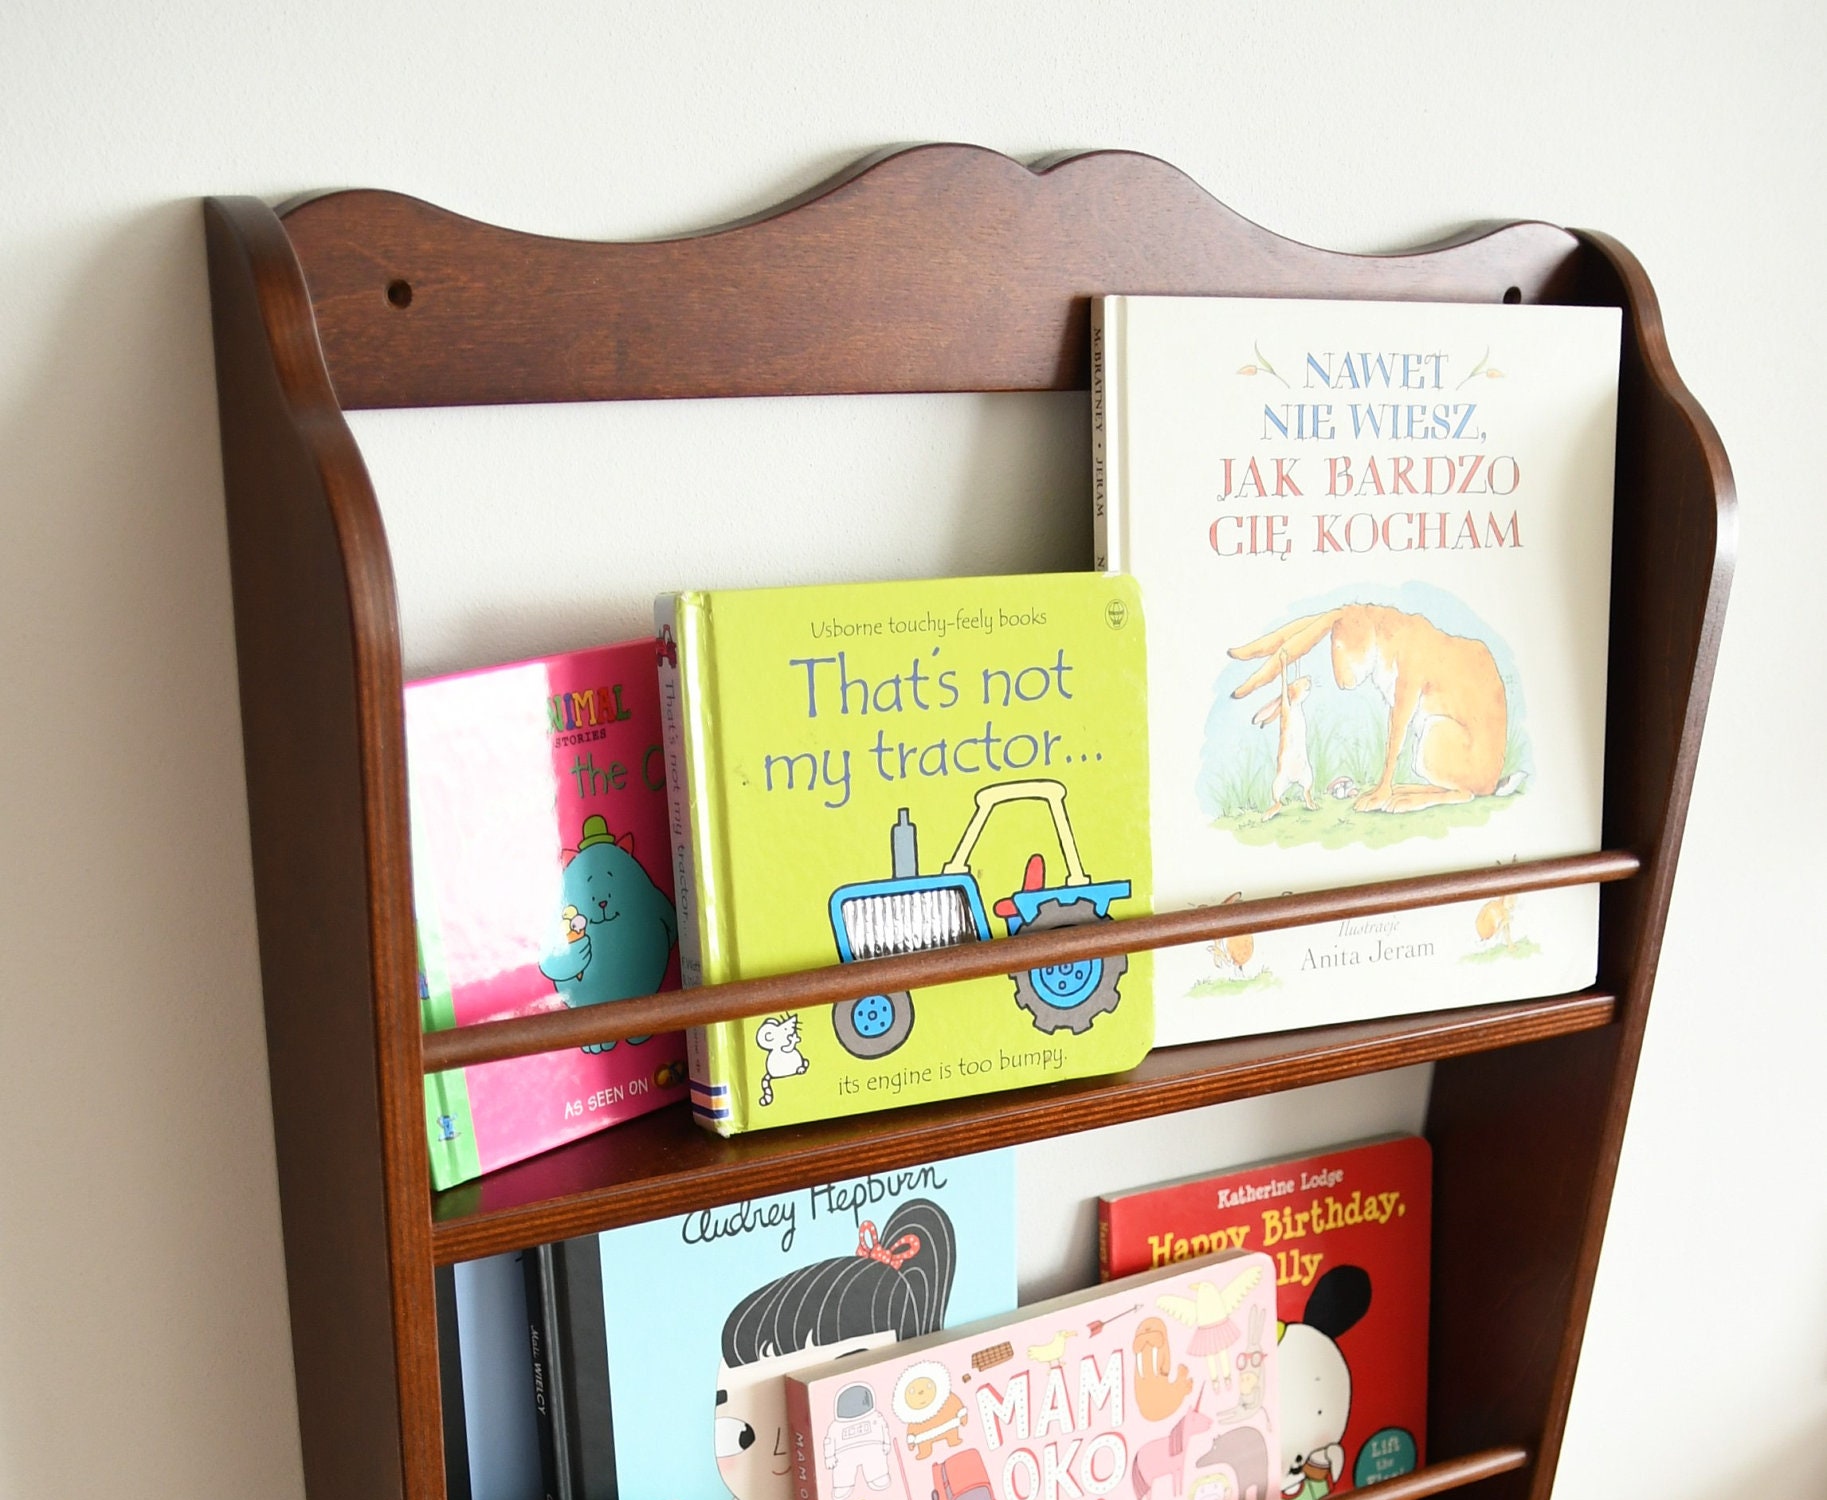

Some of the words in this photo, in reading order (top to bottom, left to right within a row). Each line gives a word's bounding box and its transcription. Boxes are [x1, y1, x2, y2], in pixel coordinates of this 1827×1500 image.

[1303, 349, 1450, 391] NAWET
[1260, 403, 1336, 442] NIE
[1346, 401, 1488, 444] WIESZ,
[1096, 457, 1105, 517] JERAM
[1216, 455, 1304, 502] JAK
[1323, 454, 1520, 500] BARDZO
[1208, 513, 1293, 561] CIĘ
[1312, 508, 1525, 555] KOCHAM
[810, 617, 883, 640] Usborne
[888, 607, 994, 638] touchy-feely
[998, 606, 1048, 629] books
[788, 645, 960, 719] That's
[981, 646, 1075, 708] not
[547, 684, 632, 734] NIMAL
[664, 680, 678, 746] That's
[554, 727, 608, 749] STORIES
[569, 751, 627, 799] the
[670, 756, 681, 792] not
[763, 743, 852, 809] my
[868, 720, 1104, 783] tractor...
[672, 799, 683, 836] my
[1338, 915, 1401, 938] Ilustracje
[1300, 943, 1361, 971] Anita
[1368, 940, 1436, 964] Jeram
[838, 1075, 860, 1096] its
[866, 1067, 933, 1095] engine
[938, 1061, 952, 1080] is
[958, 1057, 993, 1077] too
[999, 1047, 1069, 1070] bumpy.
[563, 1099, 584, 1121] AS
[587, 1084, 625, 1112] SEEN
[628, 1077, 649, 1096] ON
[681, 1201, 797, 1253] Audrey
[810, 1165, 949, 1228] Hepburn
[1217, 1178, 1296, 1210] Katherine
[1300, 1168, 1345, 1192] Lodge
[1261, 1190, 1407, 1248] Birthday,
[1276, 1249, 1325, 1287] lly
[533, 1361, 547, 1416] WIELCY
[974, 1347, 1126, 1453] MAM
[796, 1431, 808, 1480] MAM
[1371, 1436, 1401, 1458] Lift
